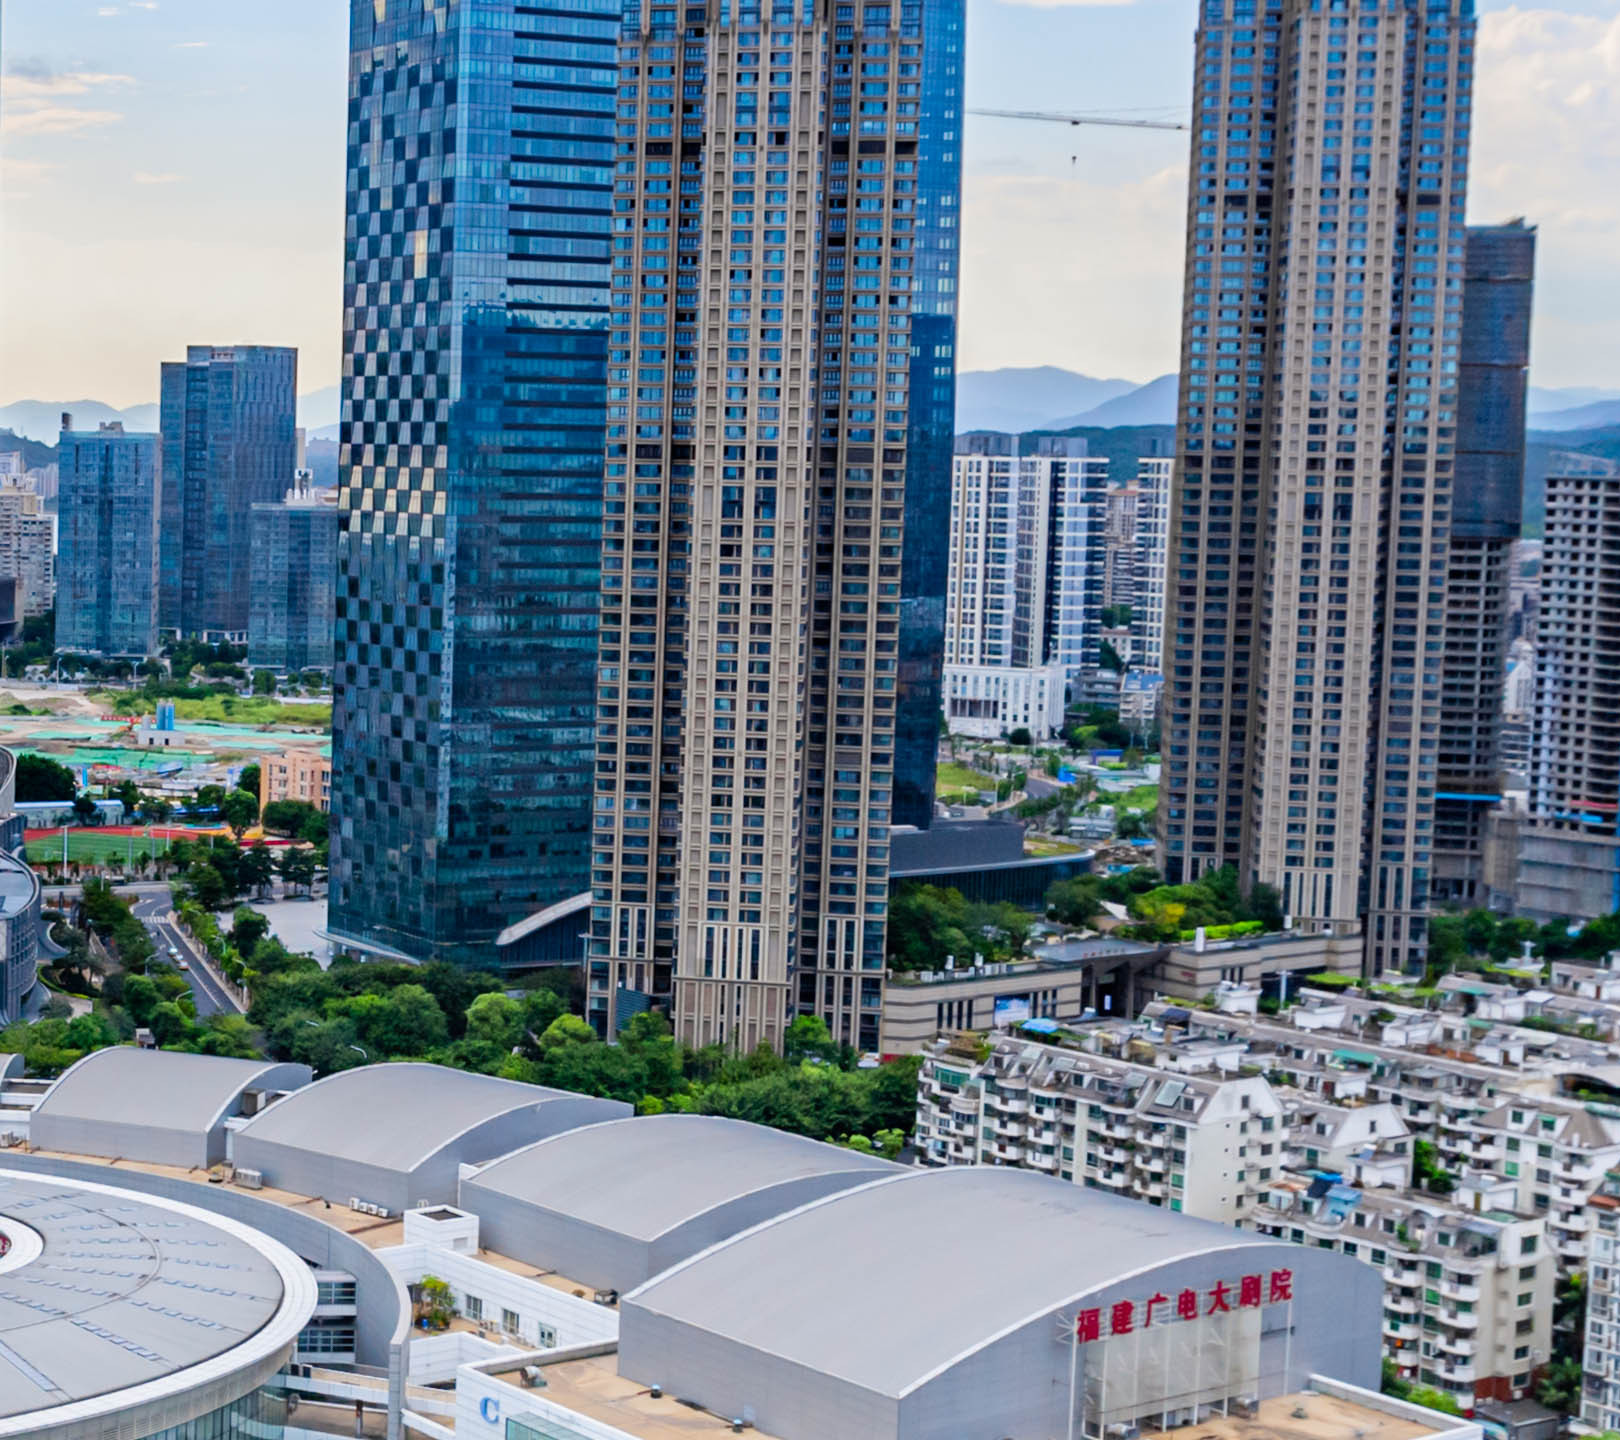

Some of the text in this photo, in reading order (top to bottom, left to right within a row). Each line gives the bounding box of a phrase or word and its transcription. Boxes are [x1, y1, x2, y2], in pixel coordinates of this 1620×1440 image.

[1076, 1268, 1294, 1344] 福建广电大剧院
[480, 1396, 500, 1425] C
